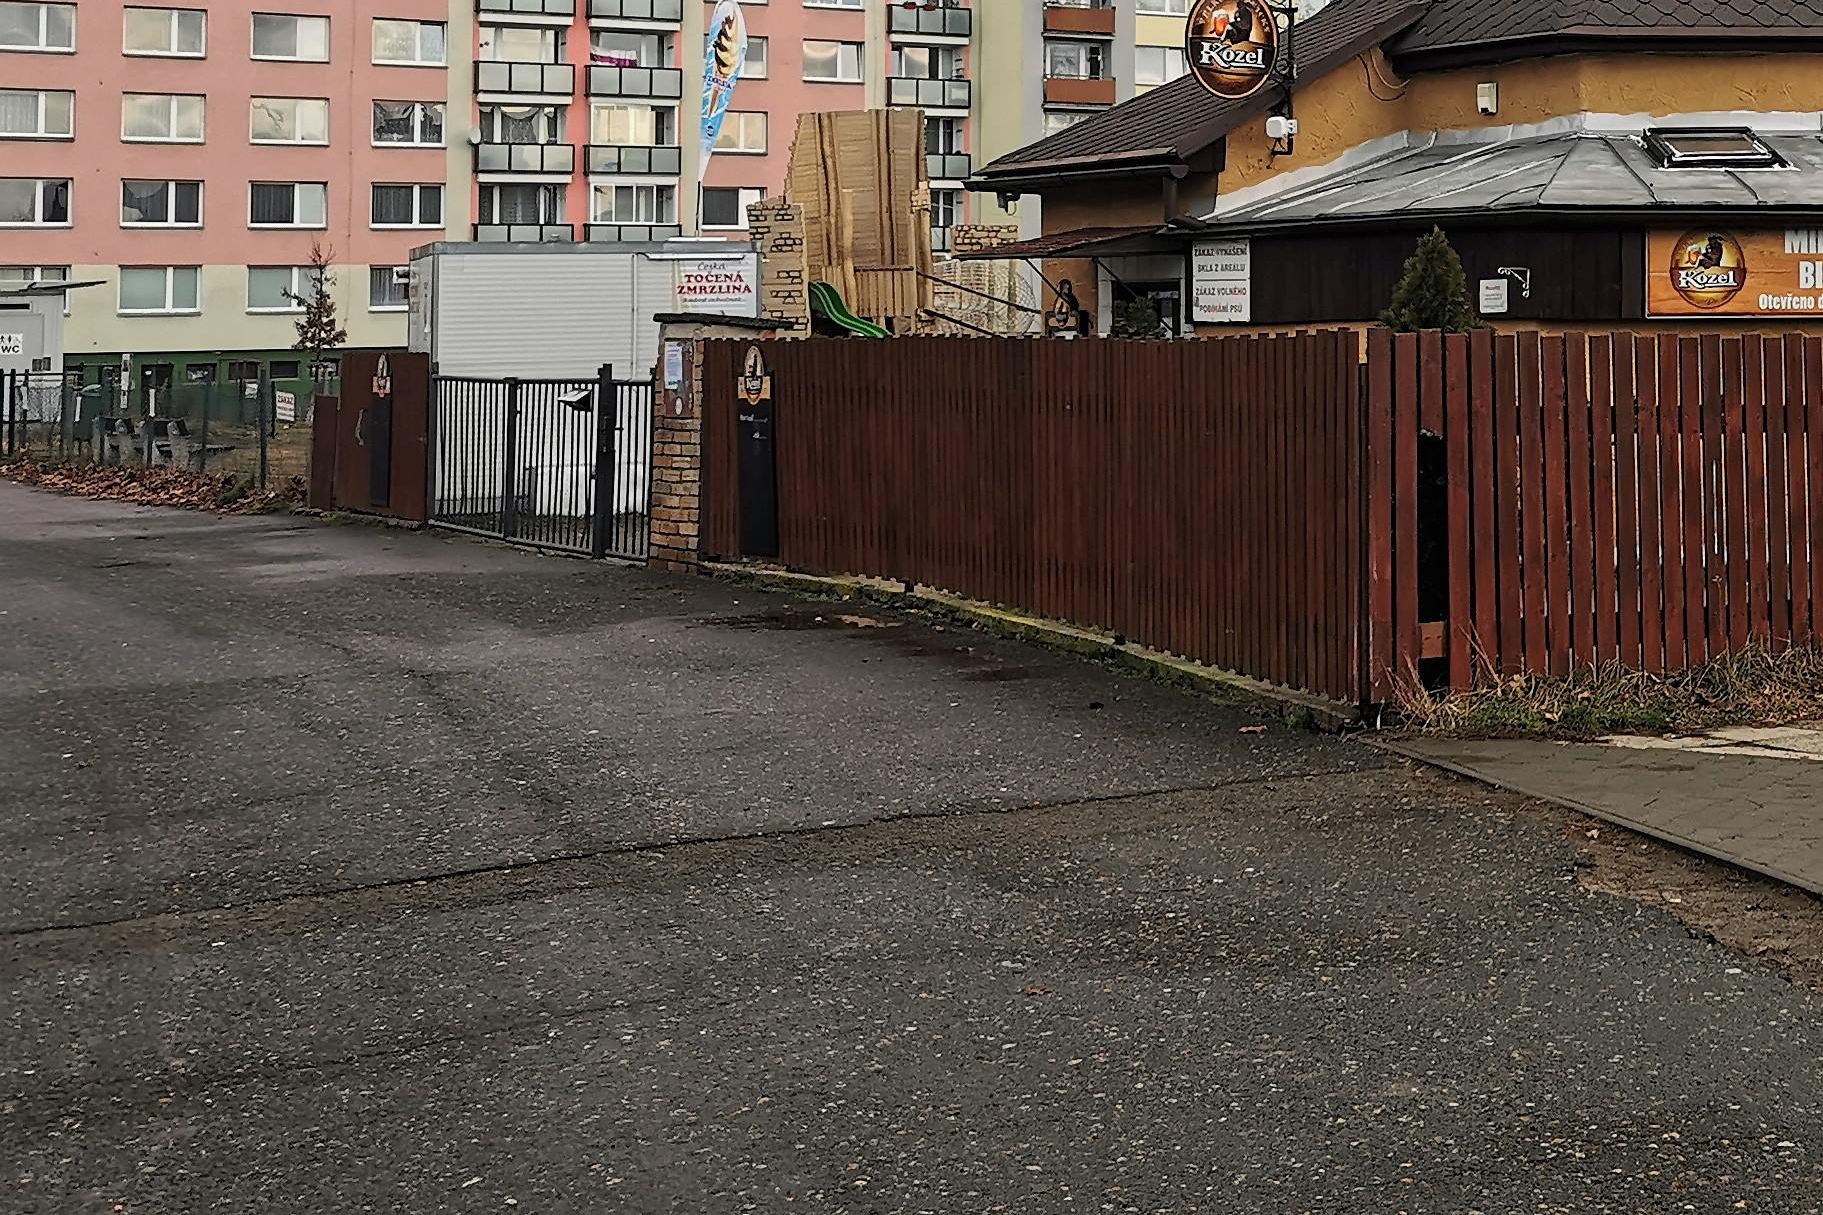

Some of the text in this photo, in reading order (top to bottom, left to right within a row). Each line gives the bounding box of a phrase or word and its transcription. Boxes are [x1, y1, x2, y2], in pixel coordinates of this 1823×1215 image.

[1200, 42, 1265, 68] Kozel
[684, 270, 744, 283] TOČENÁ
[1679, 270, 1737, 288] Kozel
[677, 285, 752, 295] ZMRZLINA
[1758, 293, 1815, 310] Otevřeno
[1, 345, 20, 354] WC
